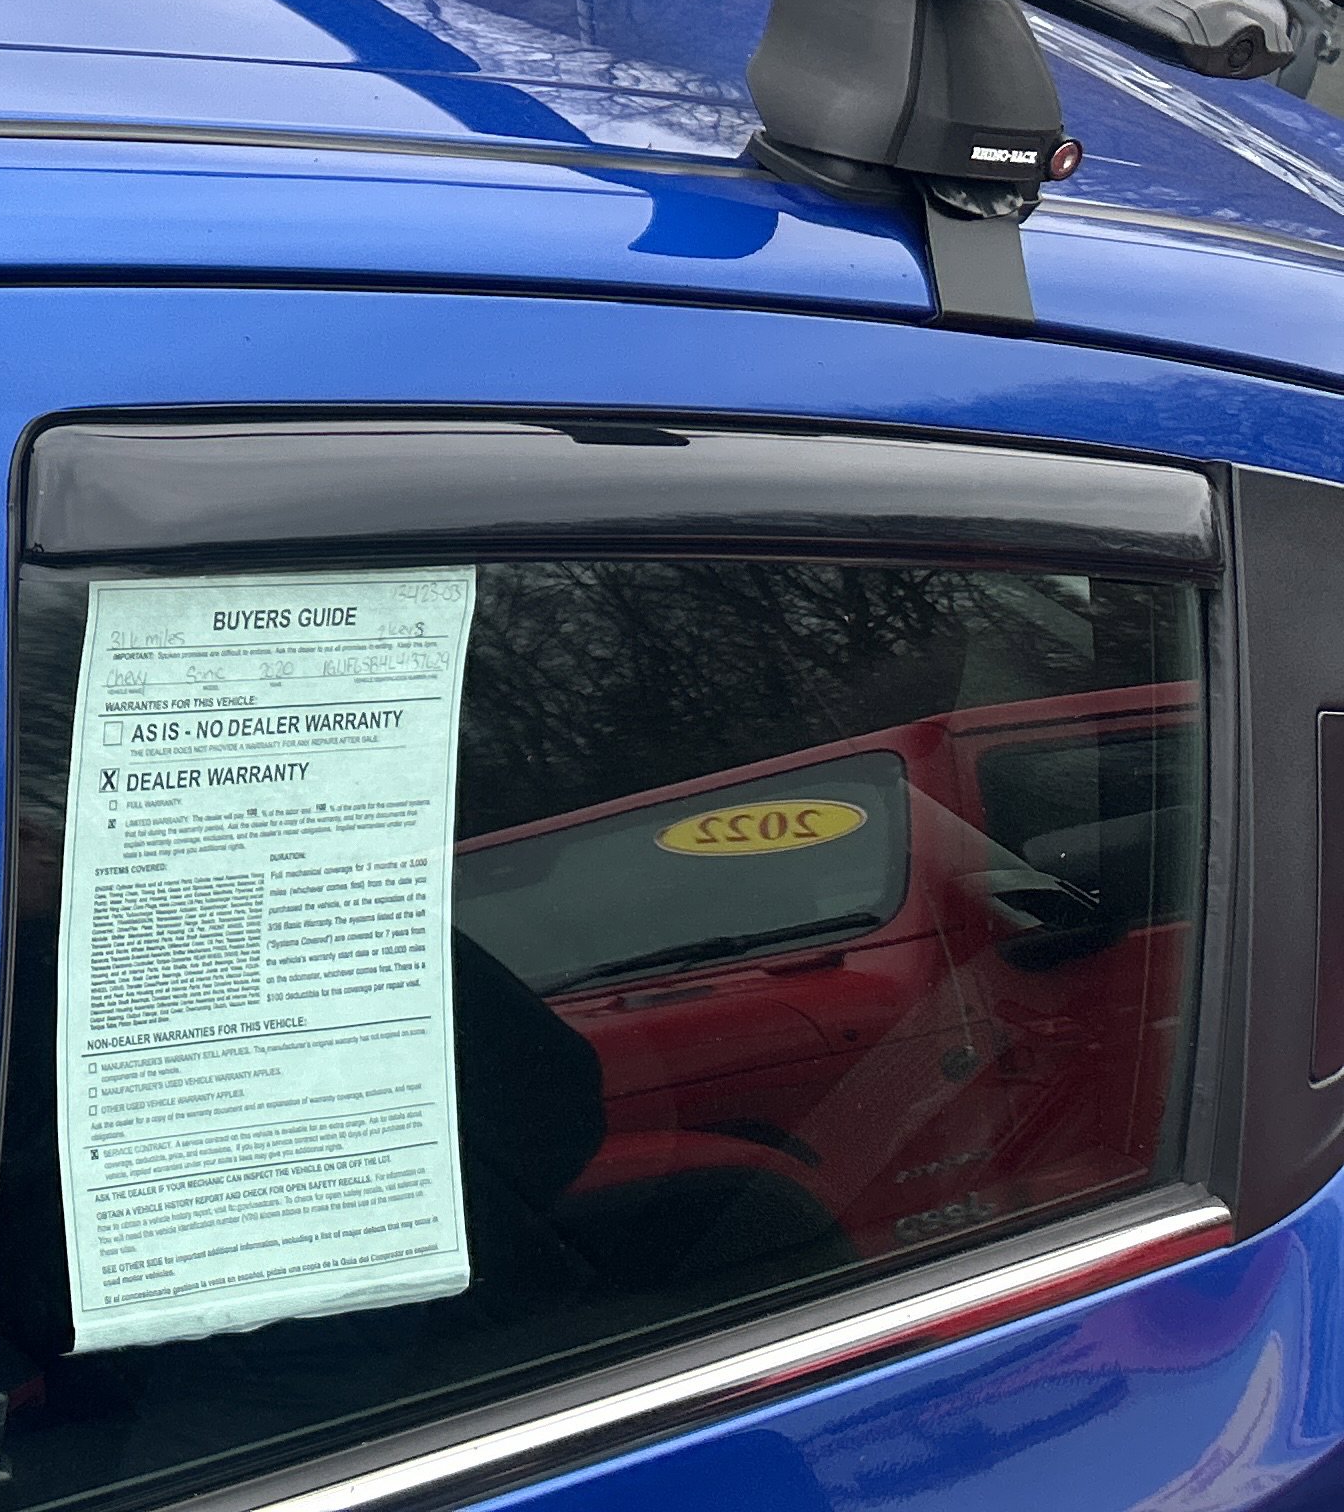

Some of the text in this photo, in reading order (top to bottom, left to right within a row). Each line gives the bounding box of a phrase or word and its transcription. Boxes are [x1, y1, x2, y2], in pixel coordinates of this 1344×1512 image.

[212, 607, 356, 630] BUYERS GUIDE
[104, 695, 257, 711] WARRANTIES FOR THIS VEHICLE:
[130, 723, 157, 742] AS
[162, 721, 180, 741] IS
[196, 719, 223, 738] NO
[227, 715, 300, 736] DEALER
[304, 710, 402, 731] WARRANTY
[101, 763, 308, 791] X DEALER WARRANTY
[86, 1016, 307, 1049] NON-DEALER WARRANTIES FOR THIS VEHICLE:
